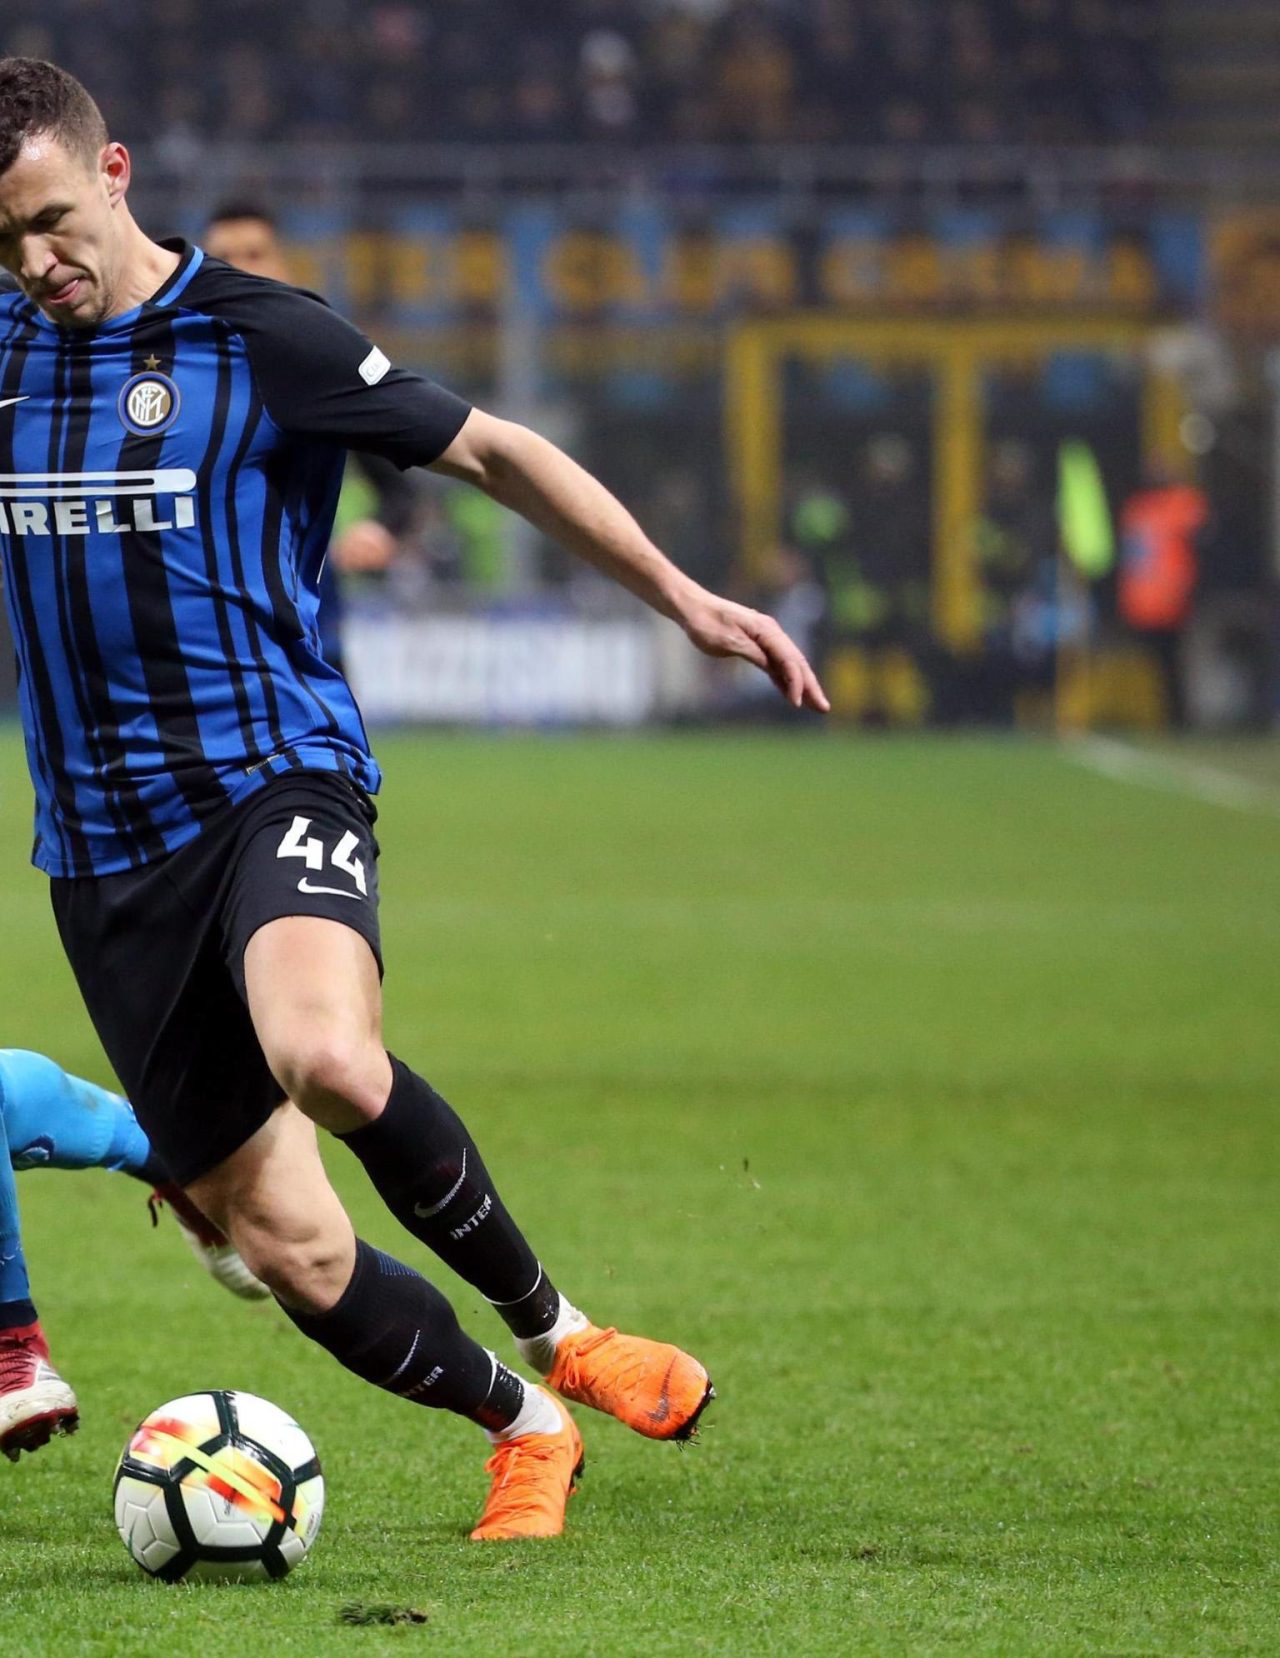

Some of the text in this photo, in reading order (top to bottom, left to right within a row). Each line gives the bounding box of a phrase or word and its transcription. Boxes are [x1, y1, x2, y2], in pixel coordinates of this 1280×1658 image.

[277, 815, 368, 897] 44
[449, 1193, 492, 1240] INTER
[399, 1366, 444, 1397] NTER
